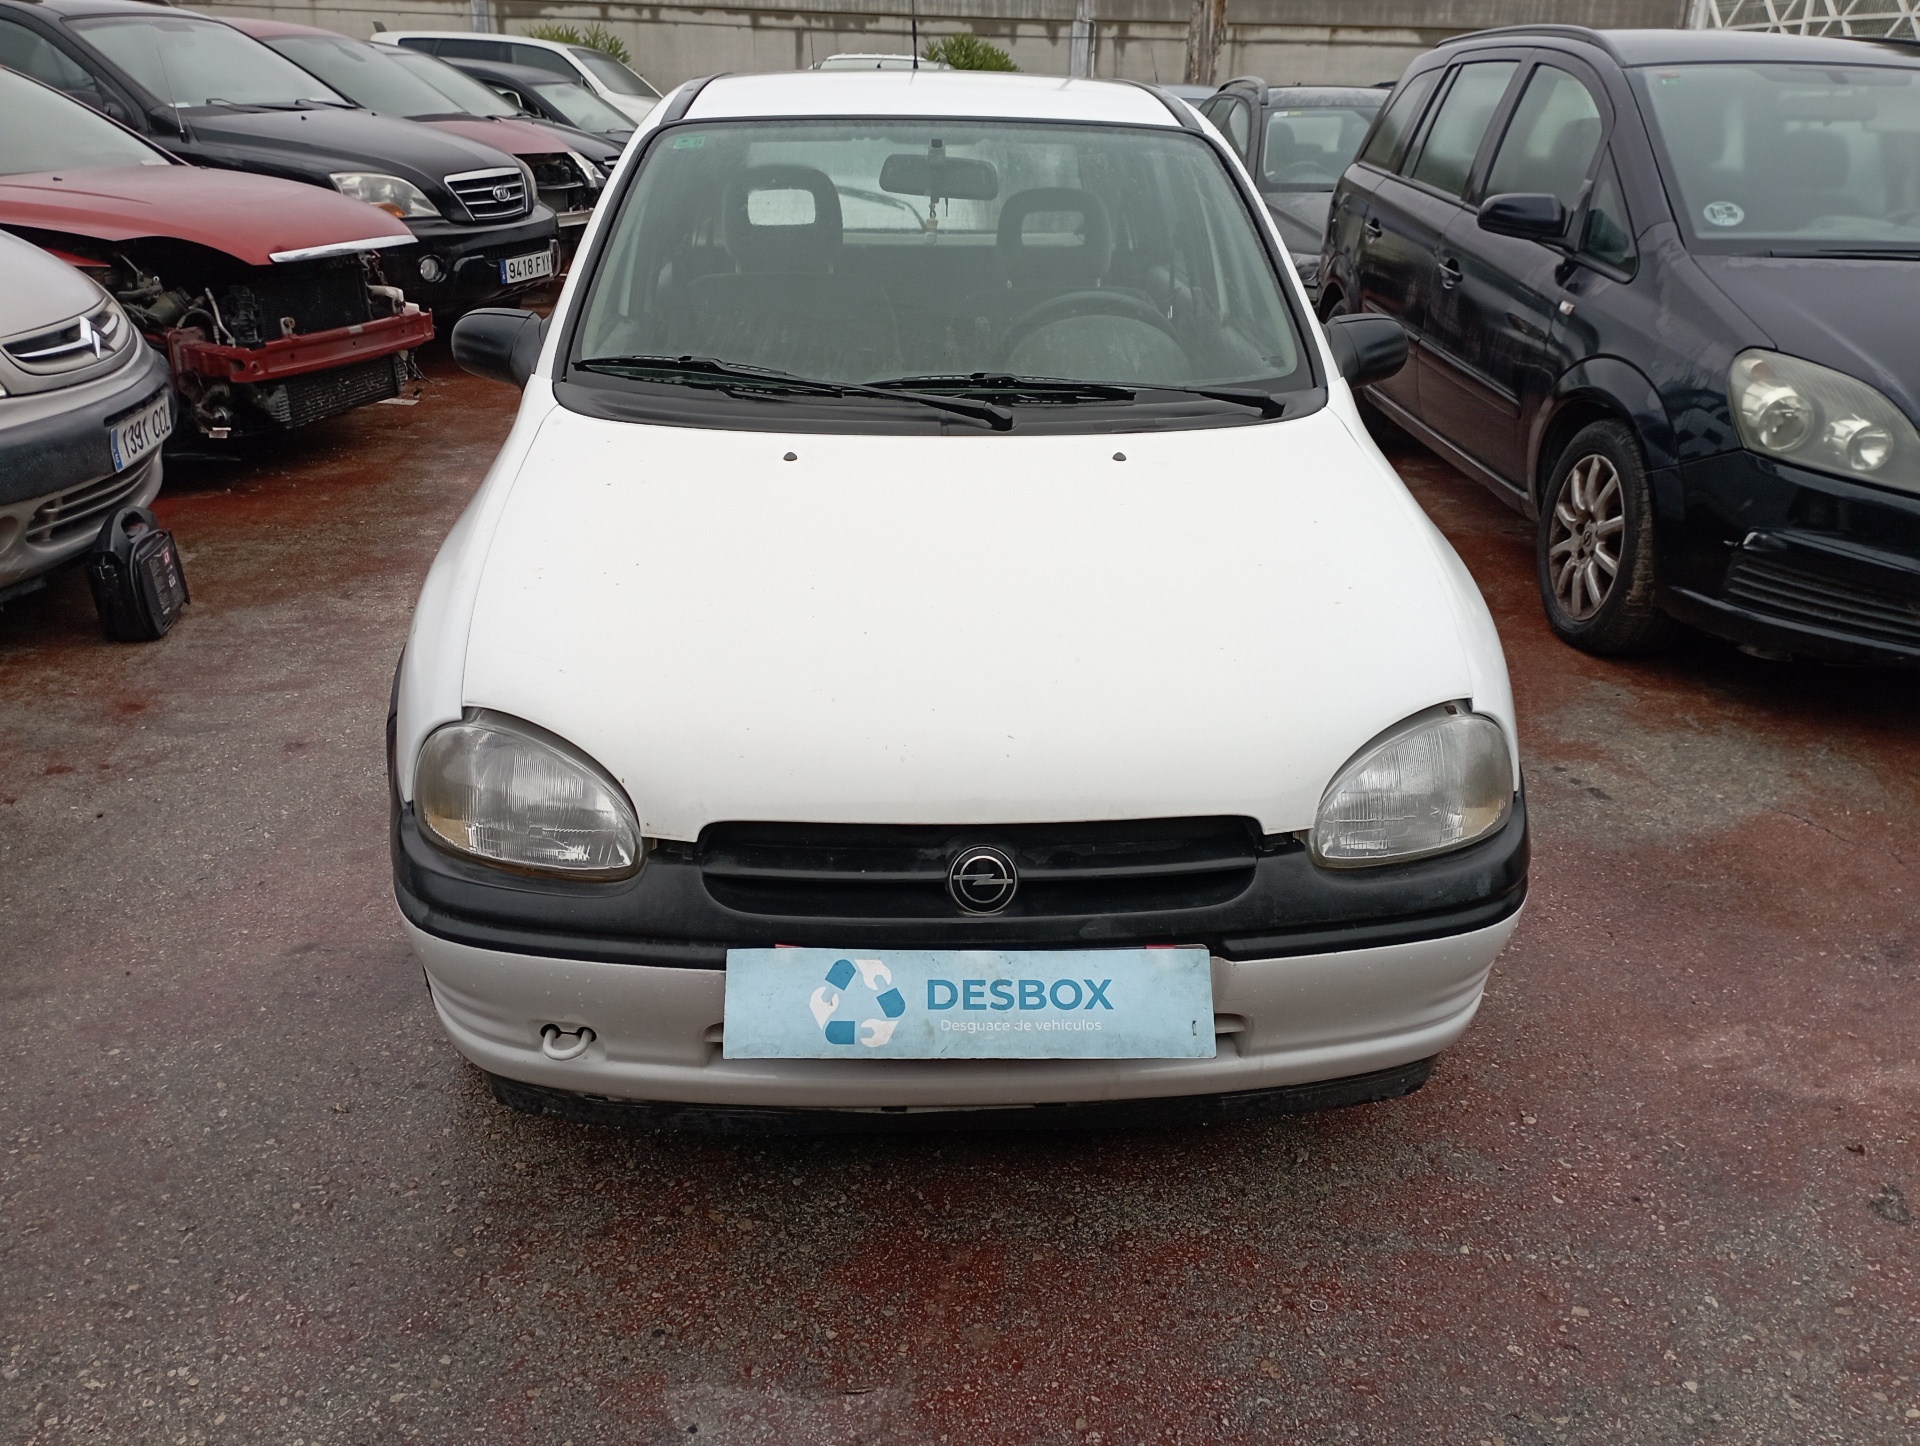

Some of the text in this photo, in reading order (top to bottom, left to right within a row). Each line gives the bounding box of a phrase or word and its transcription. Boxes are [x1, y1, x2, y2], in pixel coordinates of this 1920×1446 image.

[508, 252, 550, 279] 9418 FYY
[123, 403, 170, 459] 1391 CCL
[927, 979, 1114, 1011] DESBOX
[940, 1019, 1102, 1034] Desguace de vehículos
